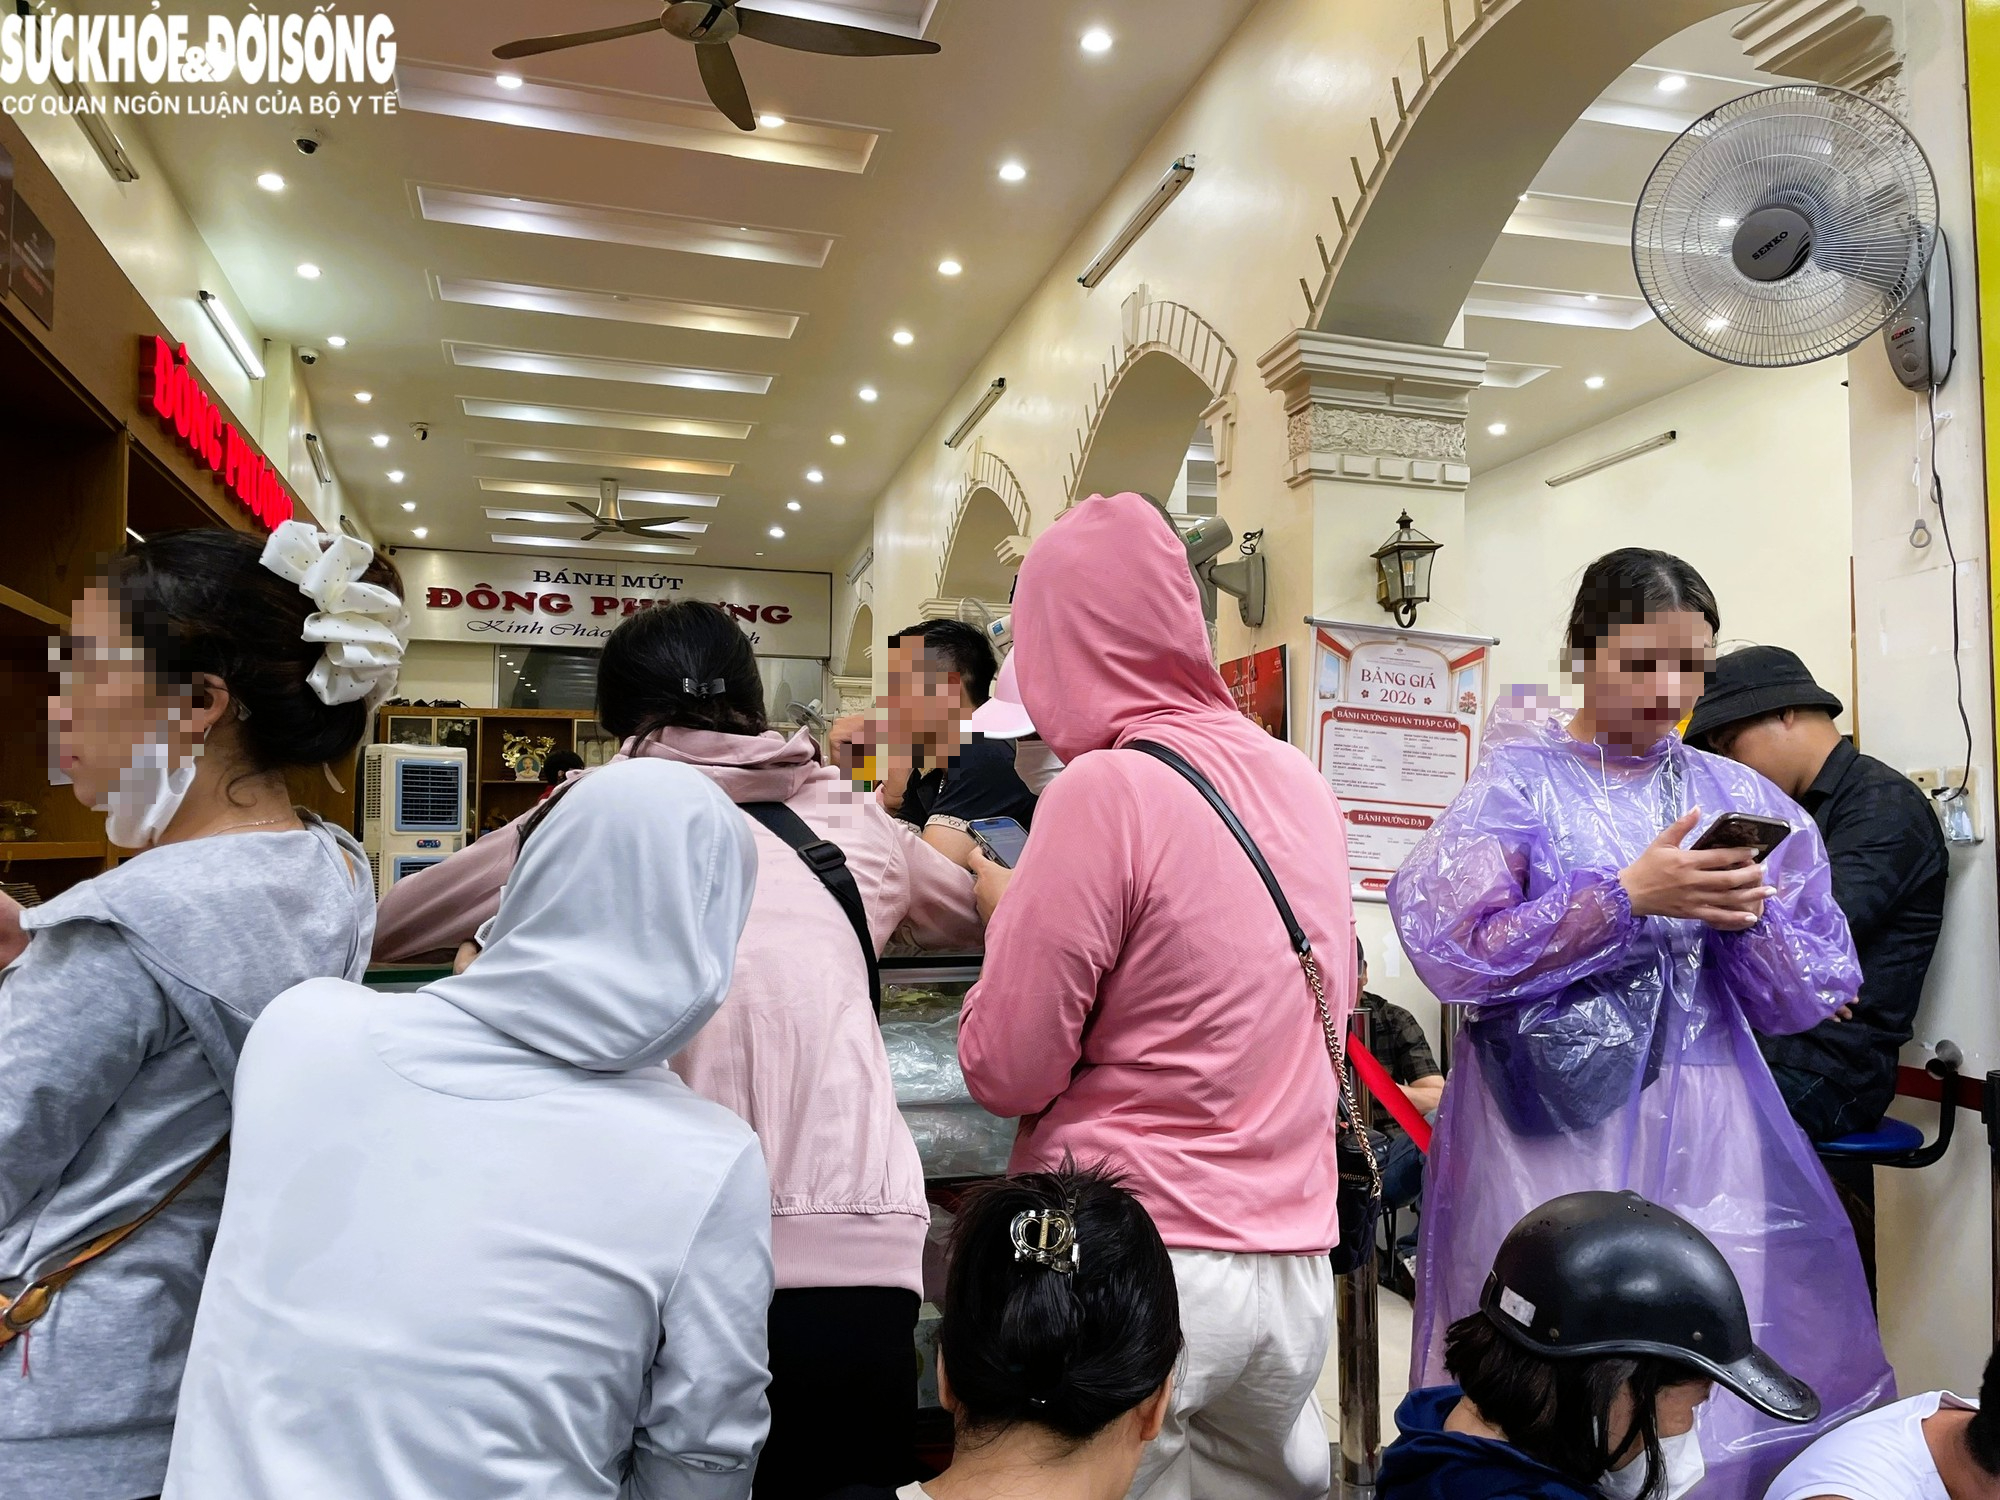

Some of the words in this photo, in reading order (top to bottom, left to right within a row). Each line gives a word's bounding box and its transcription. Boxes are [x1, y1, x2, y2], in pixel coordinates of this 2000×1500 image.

[1752, 231, 1788, 260] SENKO
[533, 568, 616, 587] BÁNH
[621, 573, 684, 591] MỨT
[426, 582, 573, 614] ĐÔNG
[466, 620, 544, 635] Kính
[1361, 666, 1406, 686] BẢNG
[1410, 673, 1437, 690] GIÁ
[1380, 688, 1416, 706] 2026
[1337, 710, 1360, 720] BÁNH
[1360, 713, 1389, 723] NƯỚNG
[1358, 813, 1381, 823] BÁNH
[1381, 815, 1410, 826] NƯỚNG
